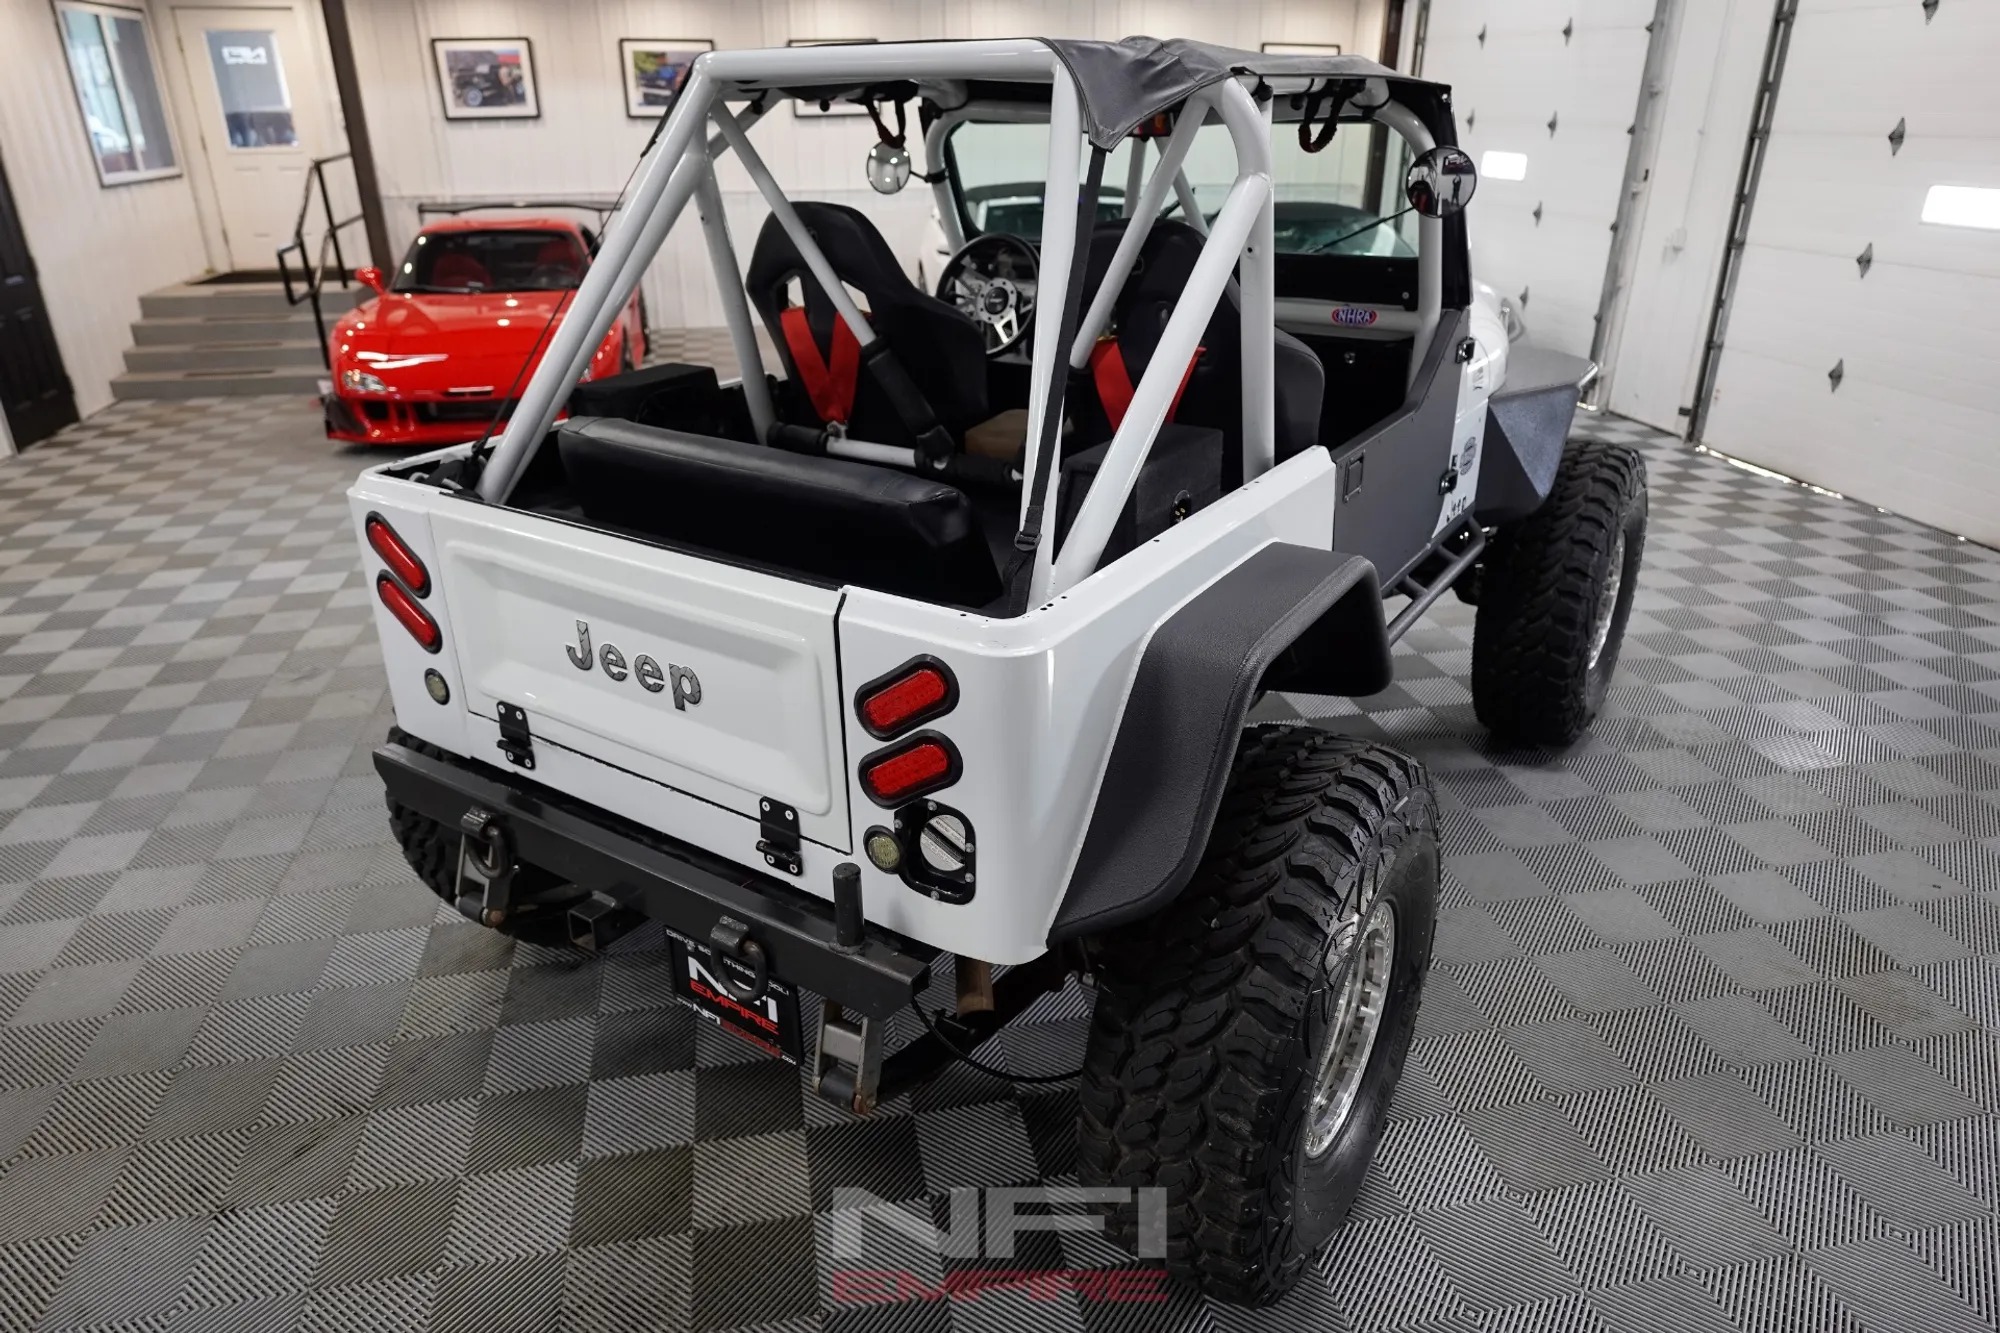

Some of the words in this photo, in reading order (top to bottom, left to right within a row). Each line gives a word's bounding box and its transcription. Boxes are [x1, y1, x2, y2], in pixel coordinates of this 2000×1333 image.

[1338, 308, 1371, 324] NHRA
[565, 619, 702, 712] Jeep
[687, 955, 779, 1024] NI
[690, 979, 781, 1036] EMPIRE
